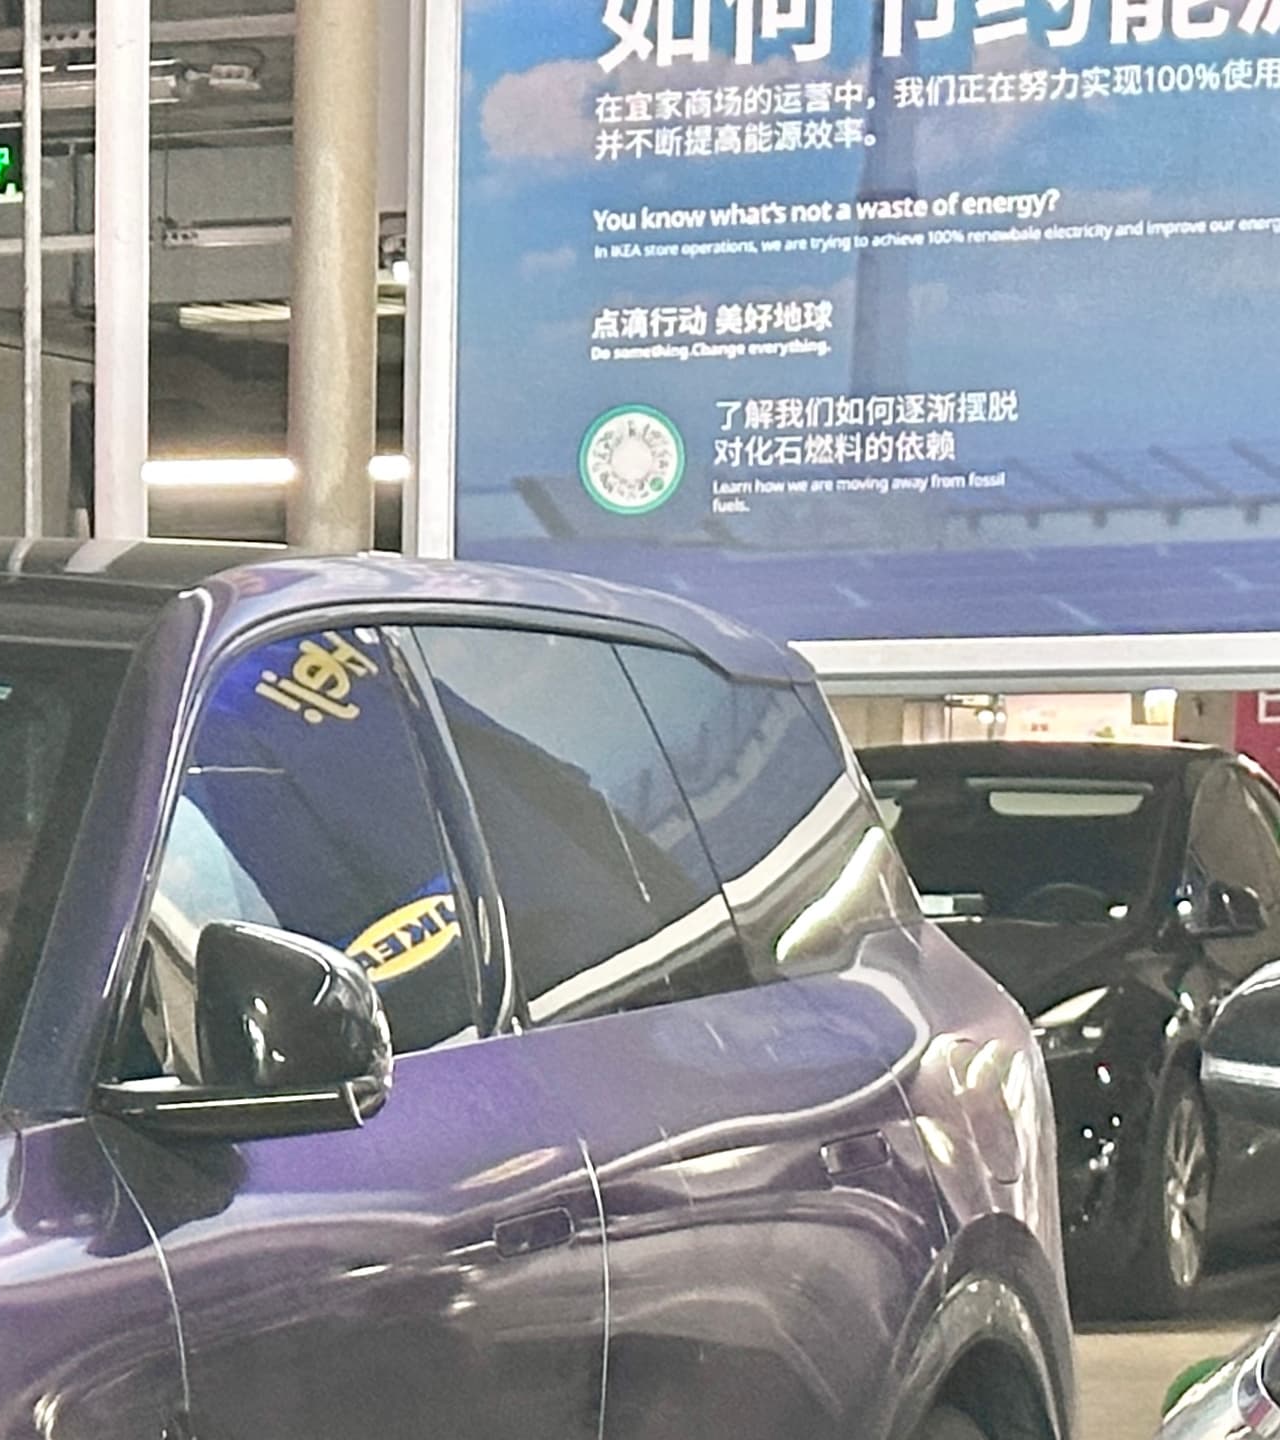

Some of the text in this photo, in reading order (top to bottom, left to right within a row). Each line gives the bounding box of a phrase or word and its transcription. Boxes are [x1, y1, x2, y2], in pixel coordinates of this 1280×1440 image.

[593, 208, 636, 231] You
[641, 206, 706, 230] know
[792, 200, 832, 222] not
[836, 202, 851, 221] a
[856, 197, 929, 220] waste
[932, 192, 960, 217] of
[962, 188, 1061, 219] energy?
[611, 243, 642, 258] IKEA
[644, 243, 678, 257] store
[761, 240, 782, 252] we
[784, 239, 807, 251] are
[810, 236, 851, 253] trying
[854, 234, 868, 248] to
[872, 231, 925, 247] achieve
[928, 229, 965, 245] 100%
[1044, 224, 1113, 241] electricity
[1115, 220, 1143, 236] and
[1147, 219, 1207, 238] improve
[1209, 219, 1236, 232] our
[591, 300, 833, 339] 点滴行动 美好地球
[591, 347, 611, 361] Do
[748, 338, 832, 357] everything.
[715, 389, 1018, 431] 了解我们如何逐渐摆脱
[713, 430, 956, 467] 对化石燃料的依赖
[713, 471, 1005, 495] Learn how we are moving away from fossil
[713, 497, 750, 513] fuels.
